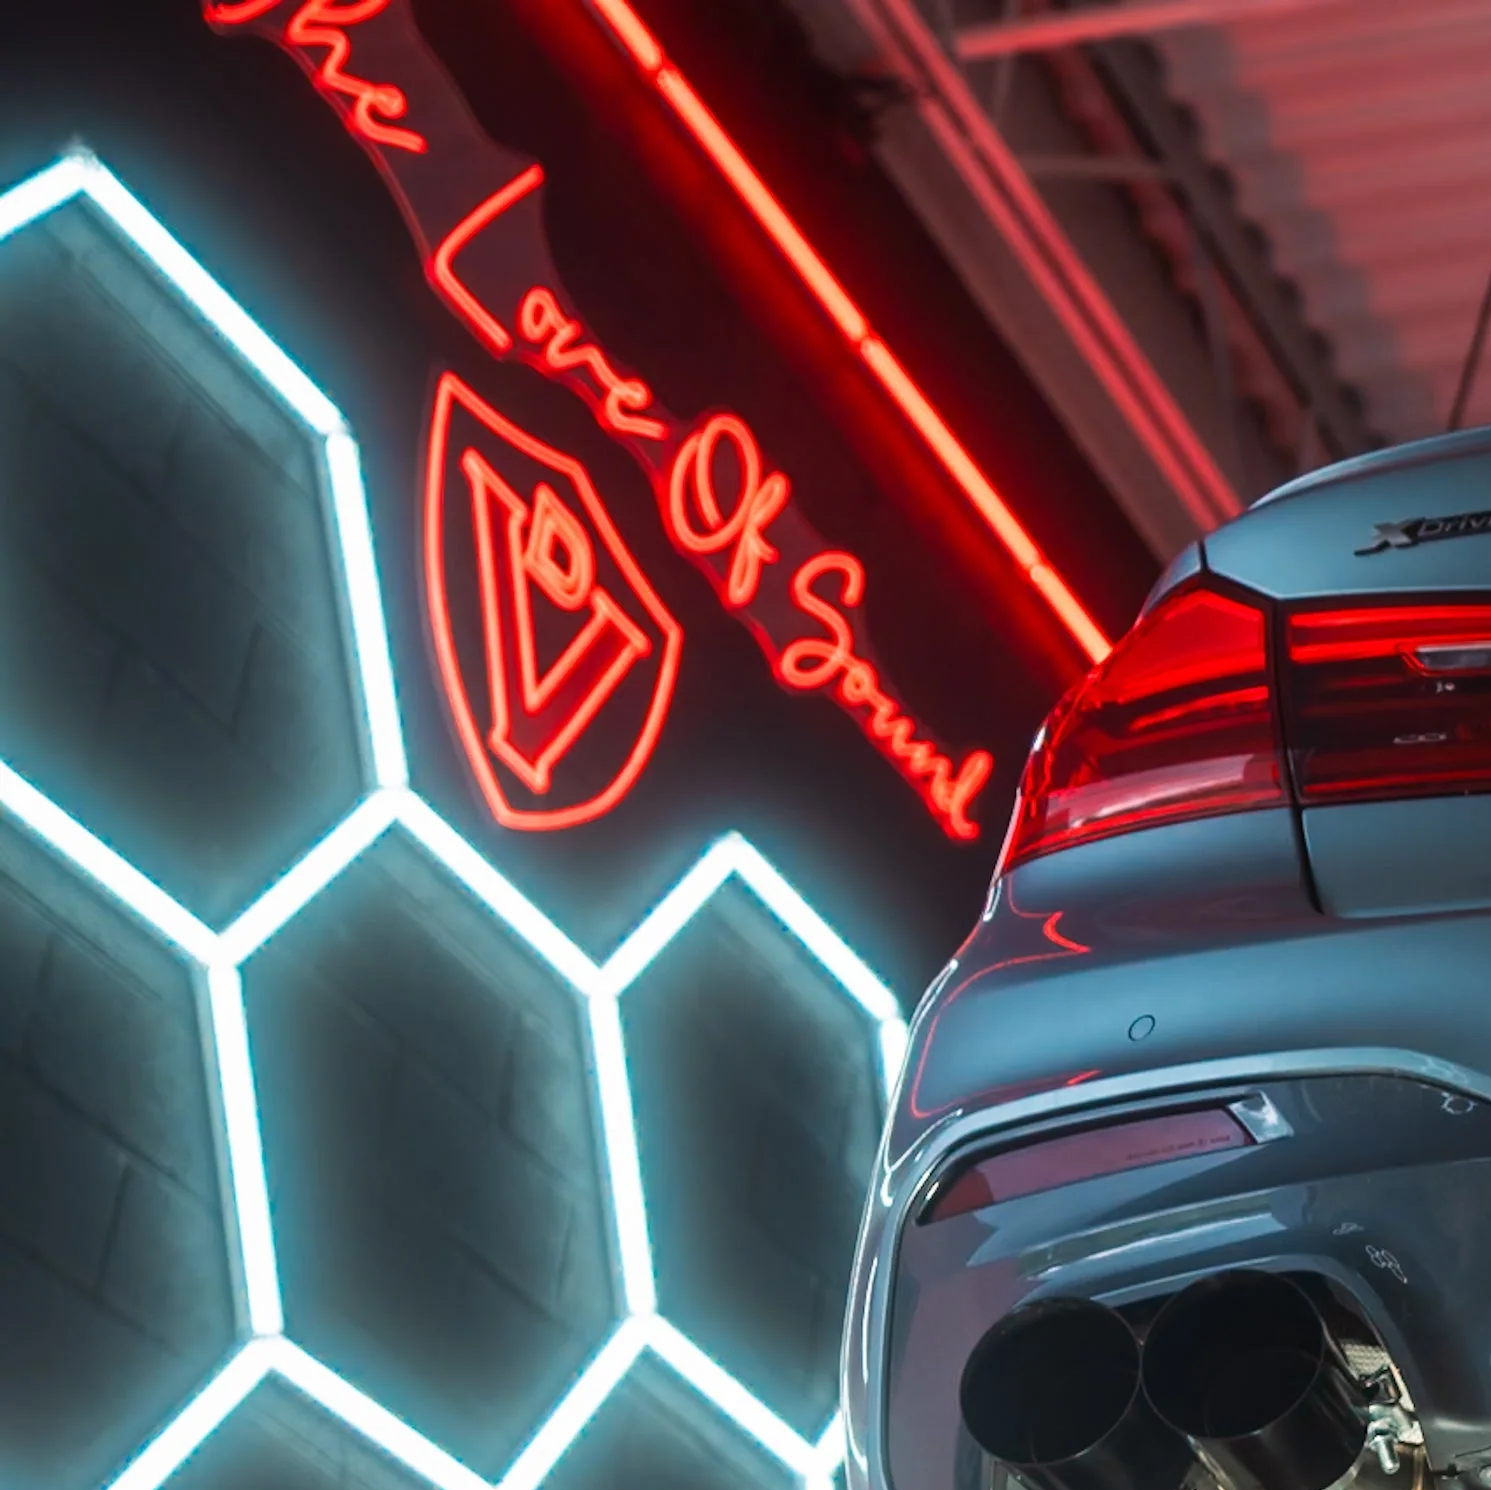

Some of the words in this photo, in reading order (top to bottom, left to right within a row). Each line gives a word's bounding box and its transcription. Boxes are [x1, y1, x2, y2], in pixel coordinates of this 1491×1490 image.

[203, 0, 428, 154] he
[424, 163, 671, 442] Love
[662, 412, 790, 606] Of
[774, 551, 993, 840] Sound
